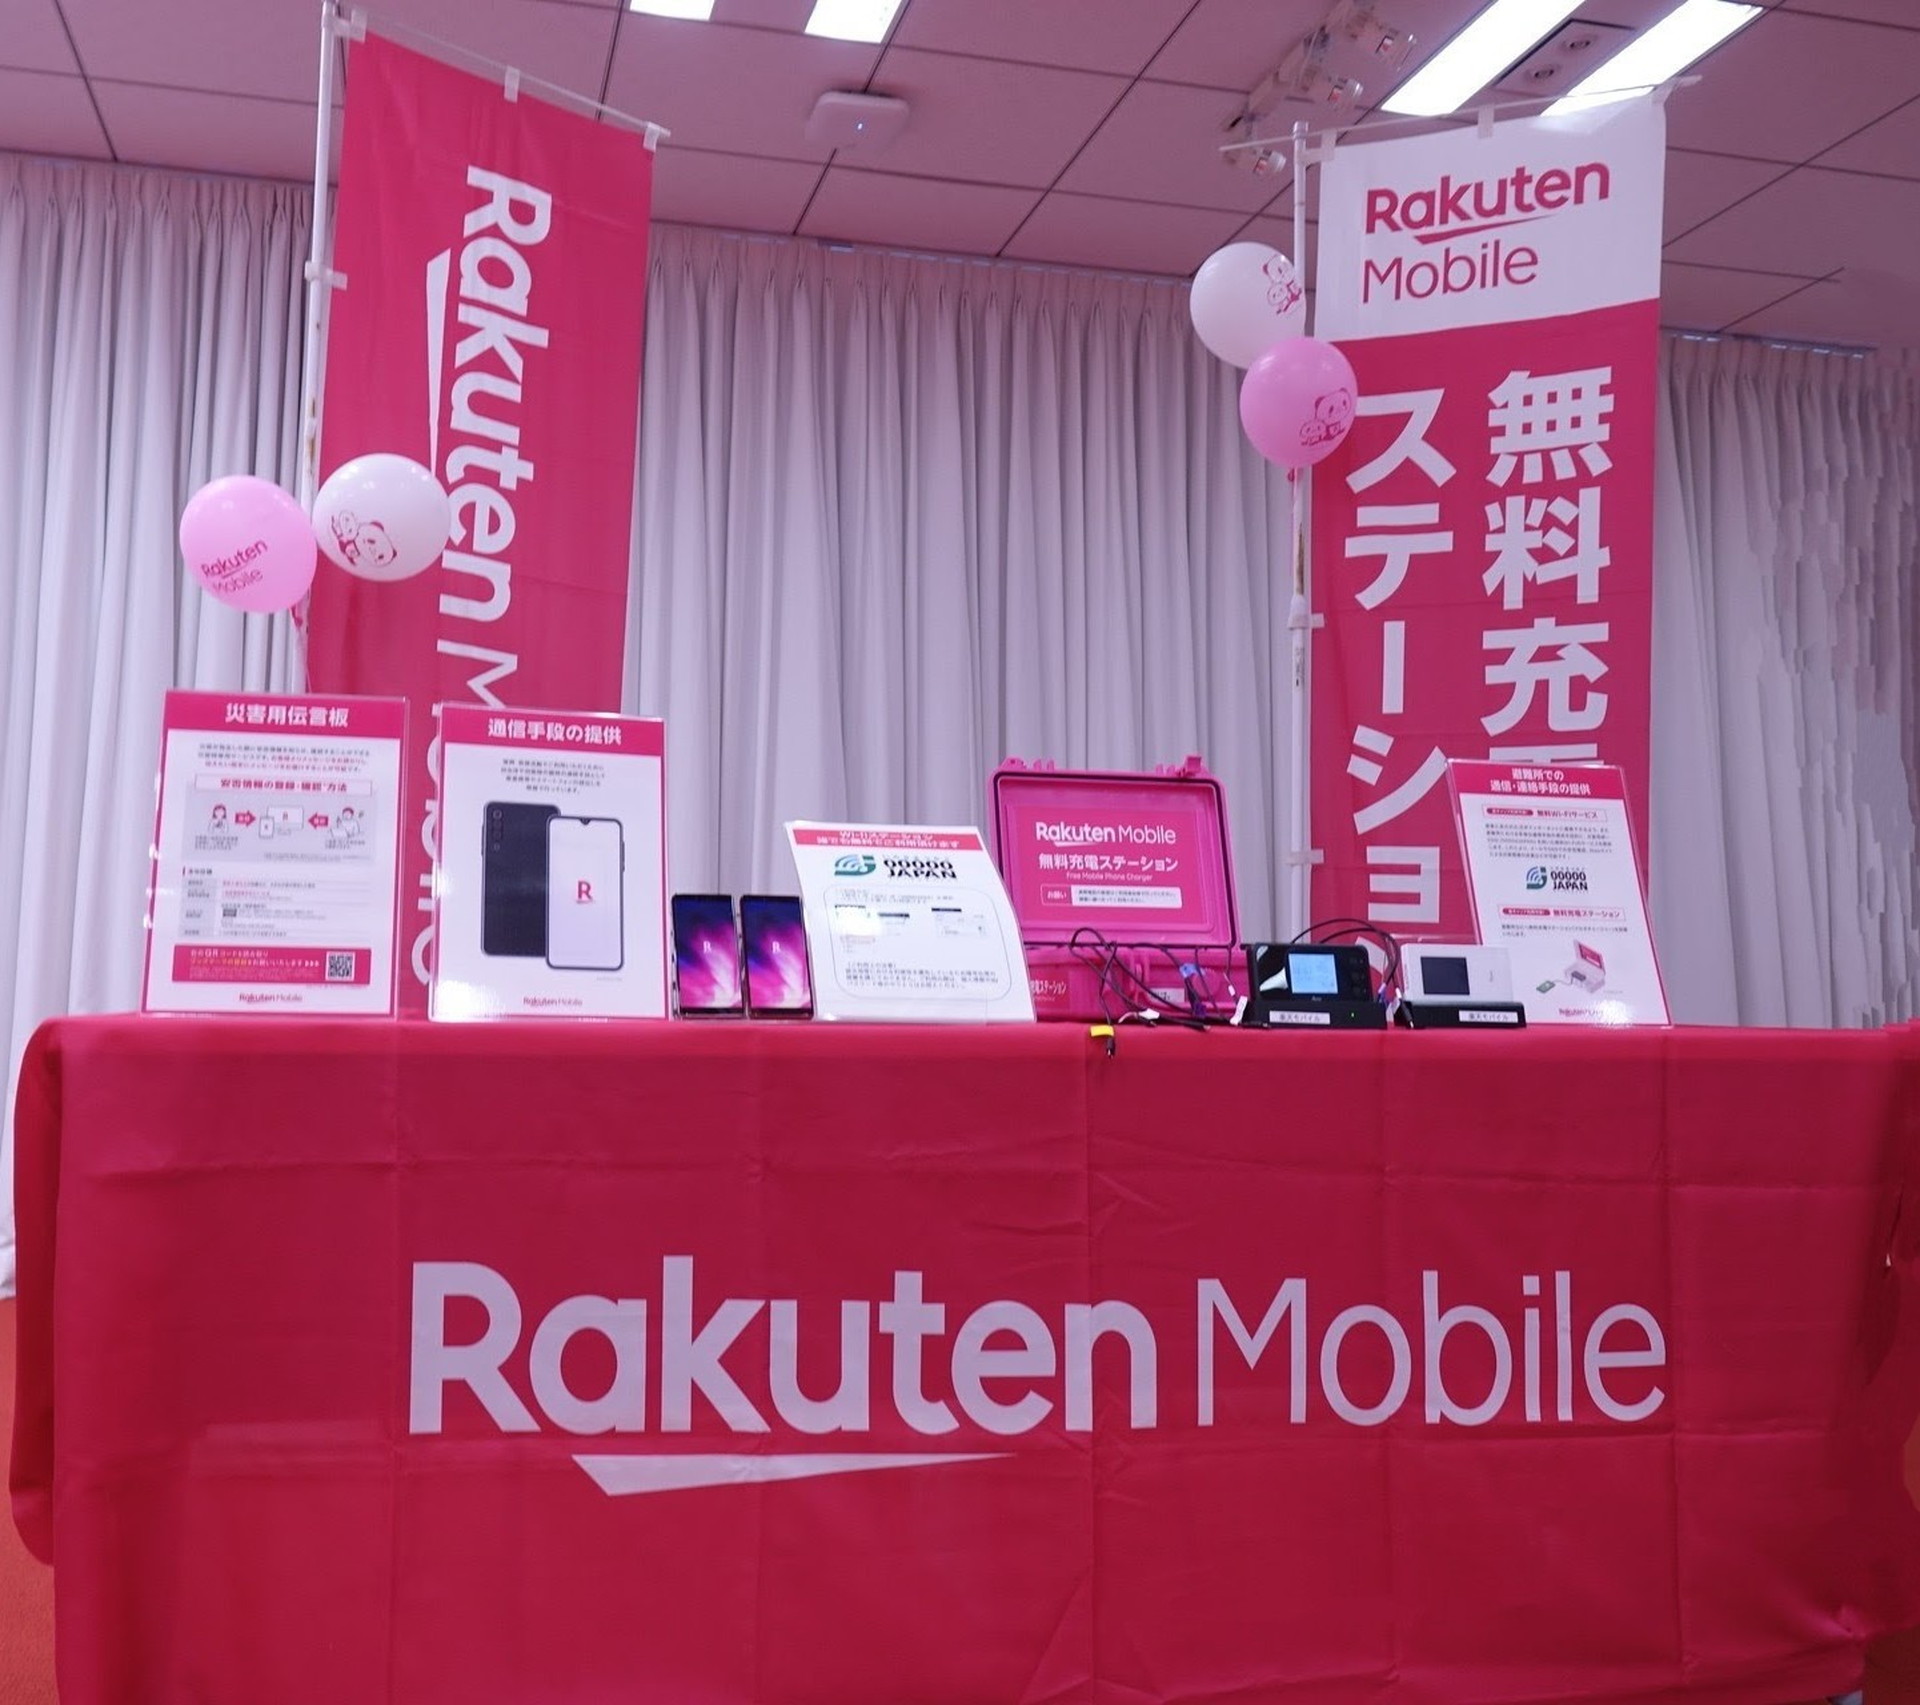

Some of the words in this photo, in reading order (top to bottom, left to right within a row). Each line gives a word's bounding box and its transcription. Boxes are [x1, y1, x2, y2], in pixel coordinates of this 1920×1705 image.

[1365, 161, 1611, 237] Rakuten
[1362, 239, 1539, 305] Mobile
[439, 165, 552, 623] Rakuten
[201, 540, 268, 577] Rakuten
[1482, 365, 1615, 765] 無料充
[1343, 387, 1457, 977] ステーショ
[225, 702, 348, 728] 災害用伝言板
[487, 718, 622, 746] 通信手段の提供
[1512, 767, 1565, 781] 避難所での
[1035, 821, 1116, 843] Rakuten
[1118, 824, 1176, 845] Mobile
[886, 869, 958, 879] JAPAN
[1038, 853, 1179, 872] 無料充電ステーション
[1550, 871, 1587, 881] 00000
[577, 880, 592, 900] R
[1553, 881, 1589, 891] JAPAN
[407, 1255, 1158, 1436] Rakuten
[1195, 1270, 1668, 1427] Mobile
